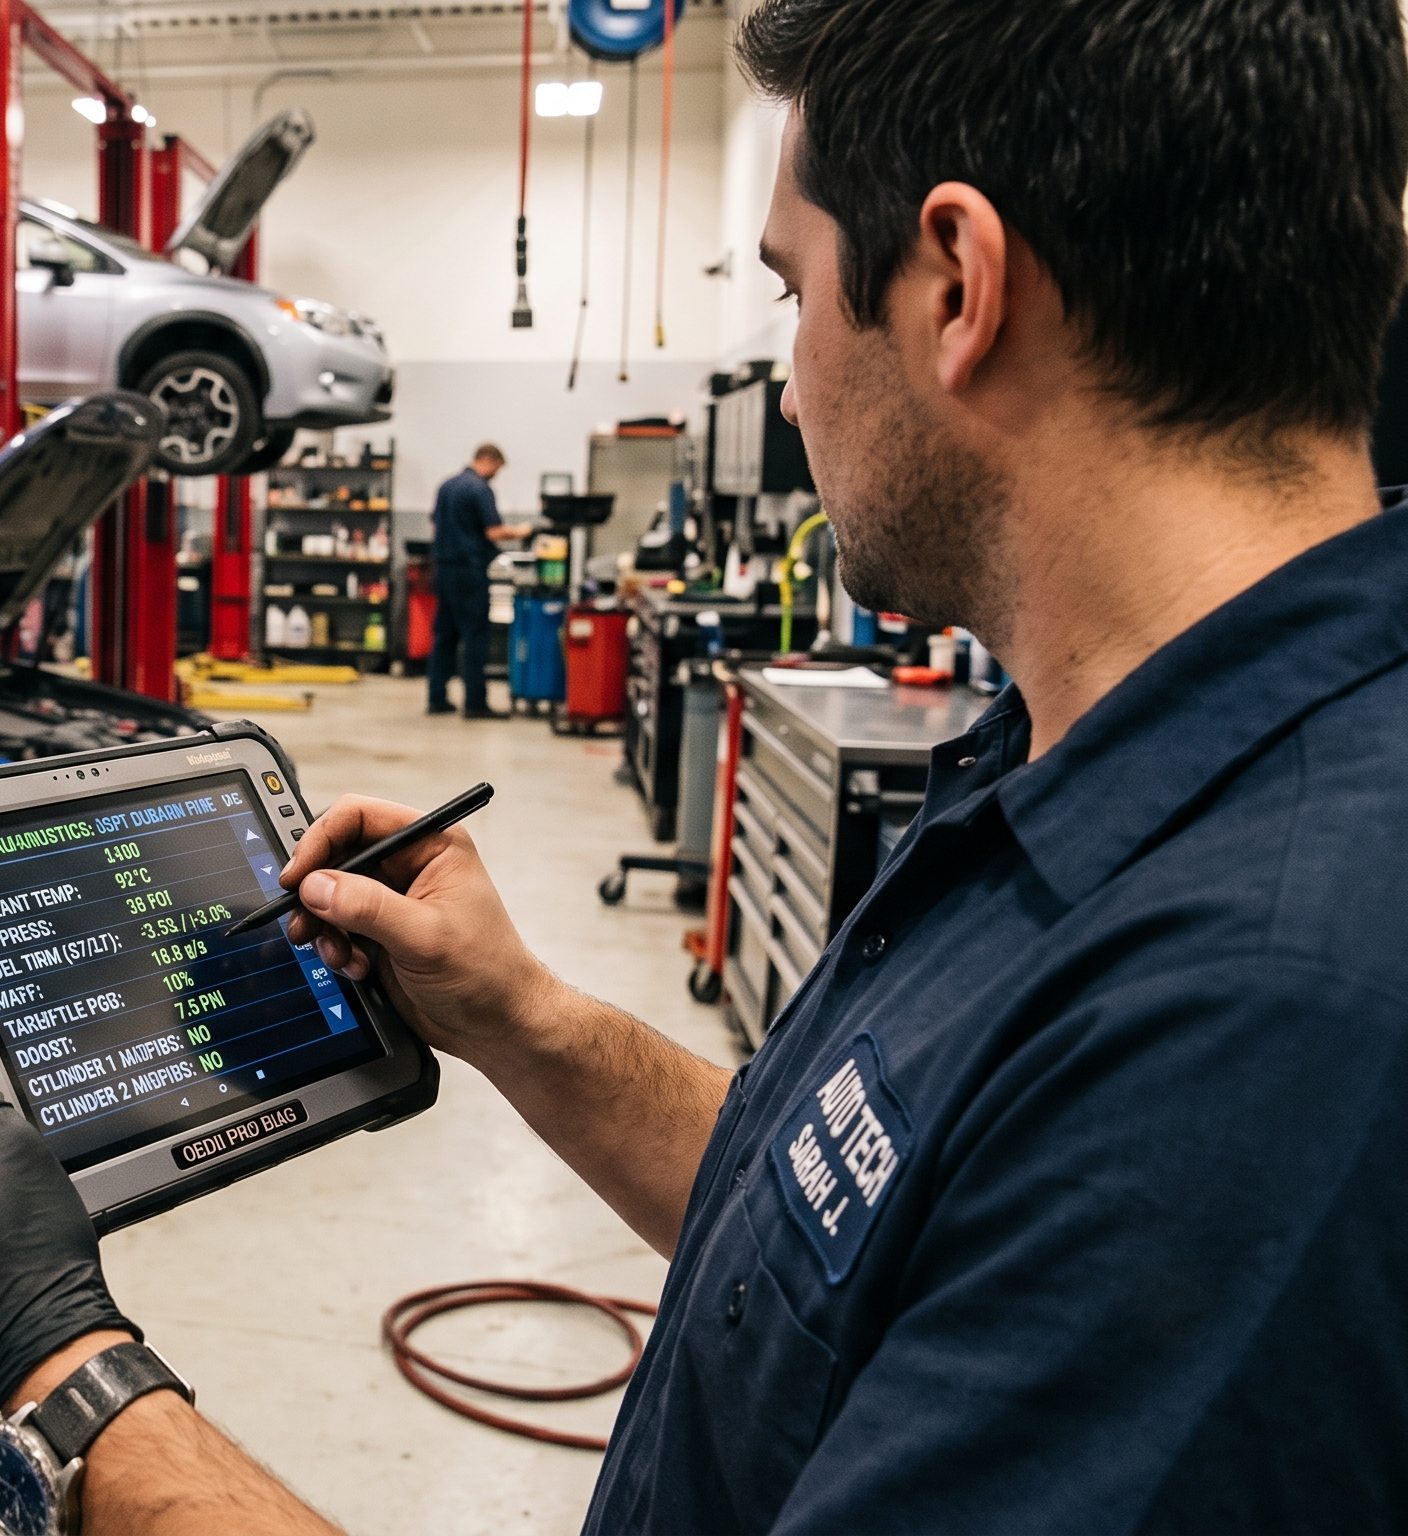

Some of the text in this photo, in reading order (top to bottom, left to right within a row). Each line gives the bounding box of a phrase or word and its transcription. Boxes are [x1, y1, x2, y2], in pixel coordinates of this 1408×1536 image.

[115, 867, 151, 889] 92°C
[163, 971, 195, 993] 10%
[15, 1036, 77, 1069] DOOST:
[174, 998, 200, 1020] 7.5
[105, 1055, 117, 1072] 1
[186, 1024, 211, 1046] NO
[118, 1081, 132, 1101] 2
[198, 1051, 224, 1073] NO
[225, 1120, 260, 1146] PRO
[816, 1058, 899, 1208] AUTO TECH
[788, 1123, 850, 1237] SARAH J.
